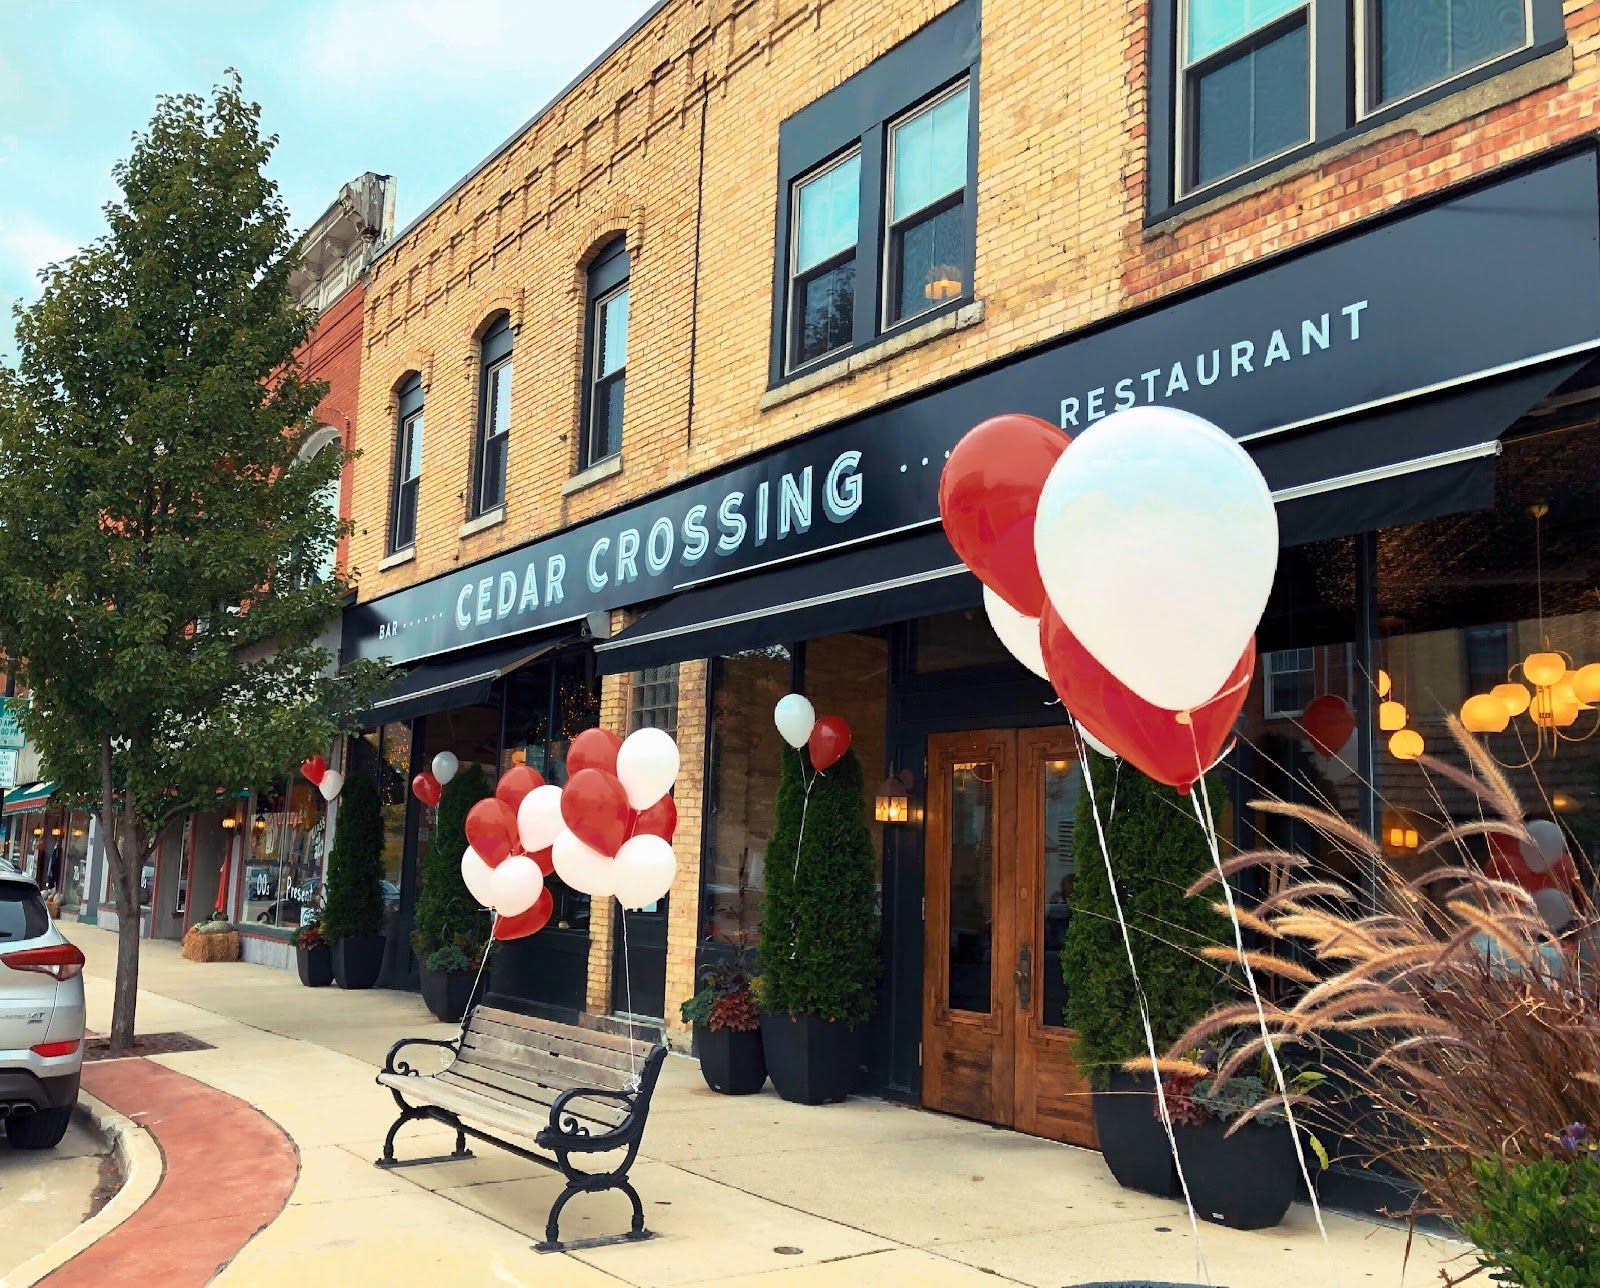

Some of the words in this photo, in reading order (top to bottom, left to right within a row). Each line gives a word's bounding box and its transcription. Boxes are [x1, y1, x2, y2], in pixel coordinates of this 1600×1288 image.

[1060, 300, 1368, 430] RESTAURANT
[455, 553, 567, 631] CEDAR
[587, 450, 863, 593] CROSSING
[379, 620, 399, 640] BAR
[286, 875, 314, 902] Present
